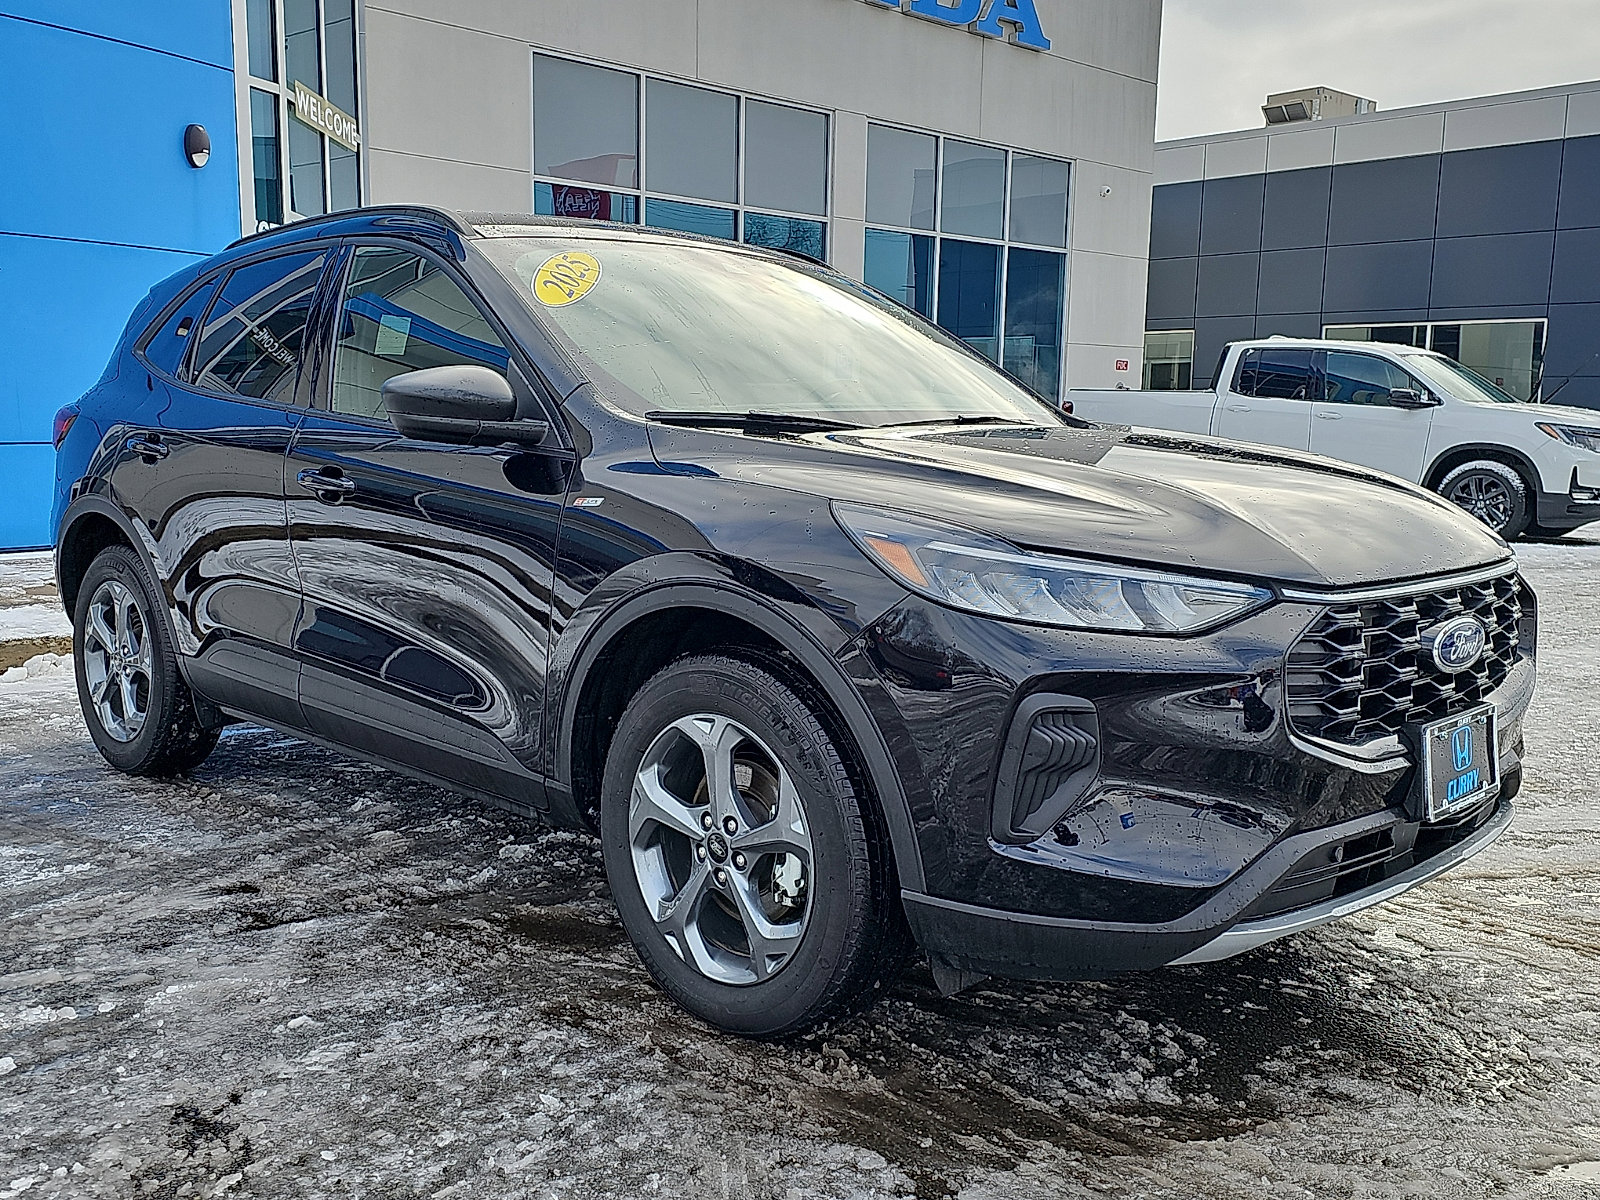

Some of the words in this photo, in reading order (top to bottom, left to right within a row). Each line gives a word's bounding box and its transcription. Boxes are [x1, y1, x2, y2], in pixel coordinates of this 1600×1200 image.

[296, 86, 357, 147] WELCOME
[543, 255, 590, 298] 2025
[1451, 628, 1480, 660] Ford
[1447, 768, 1480, 800] CURRY
